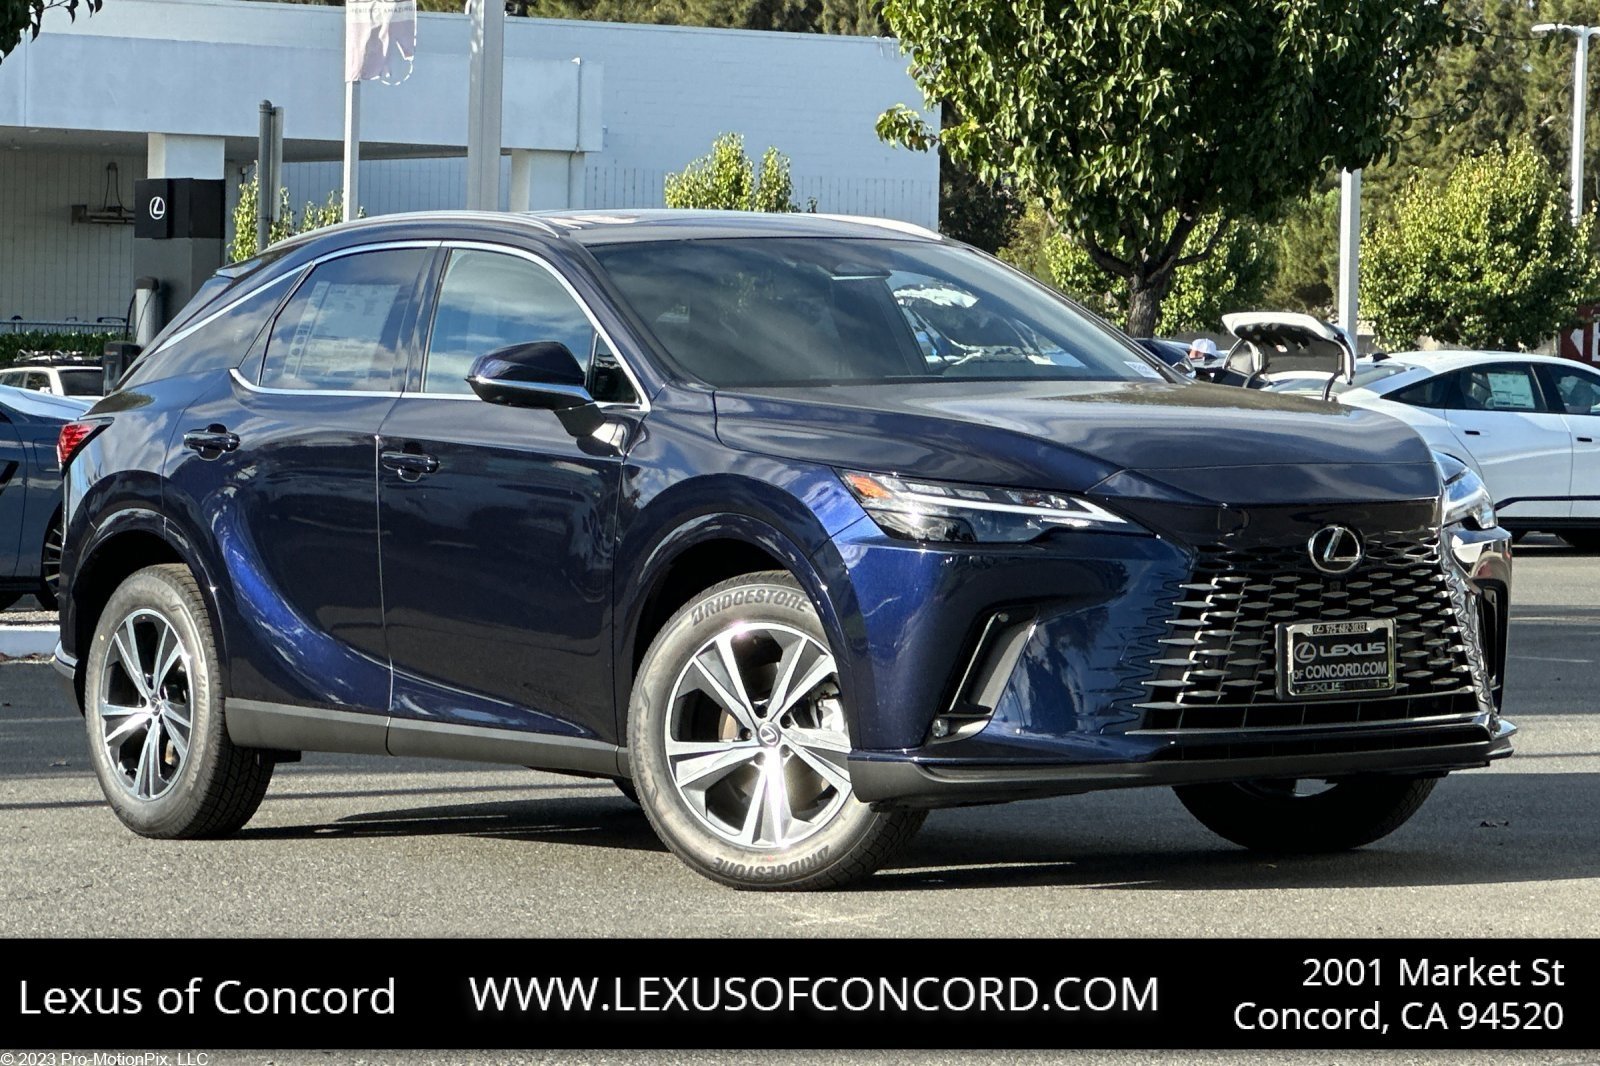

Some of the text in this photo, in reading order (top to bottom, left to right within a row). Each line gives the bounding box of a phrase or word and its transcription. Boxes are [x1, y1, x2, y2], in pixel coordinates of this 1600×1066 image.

[691, 589, 808, 626] BRIDGESTONE
[1320, 642, 1386, 657] LEXUS
[1294, 661, 1387, 680] OF CONCORD.COM
[713, 844, 830, 880] BRIDGESTONE
